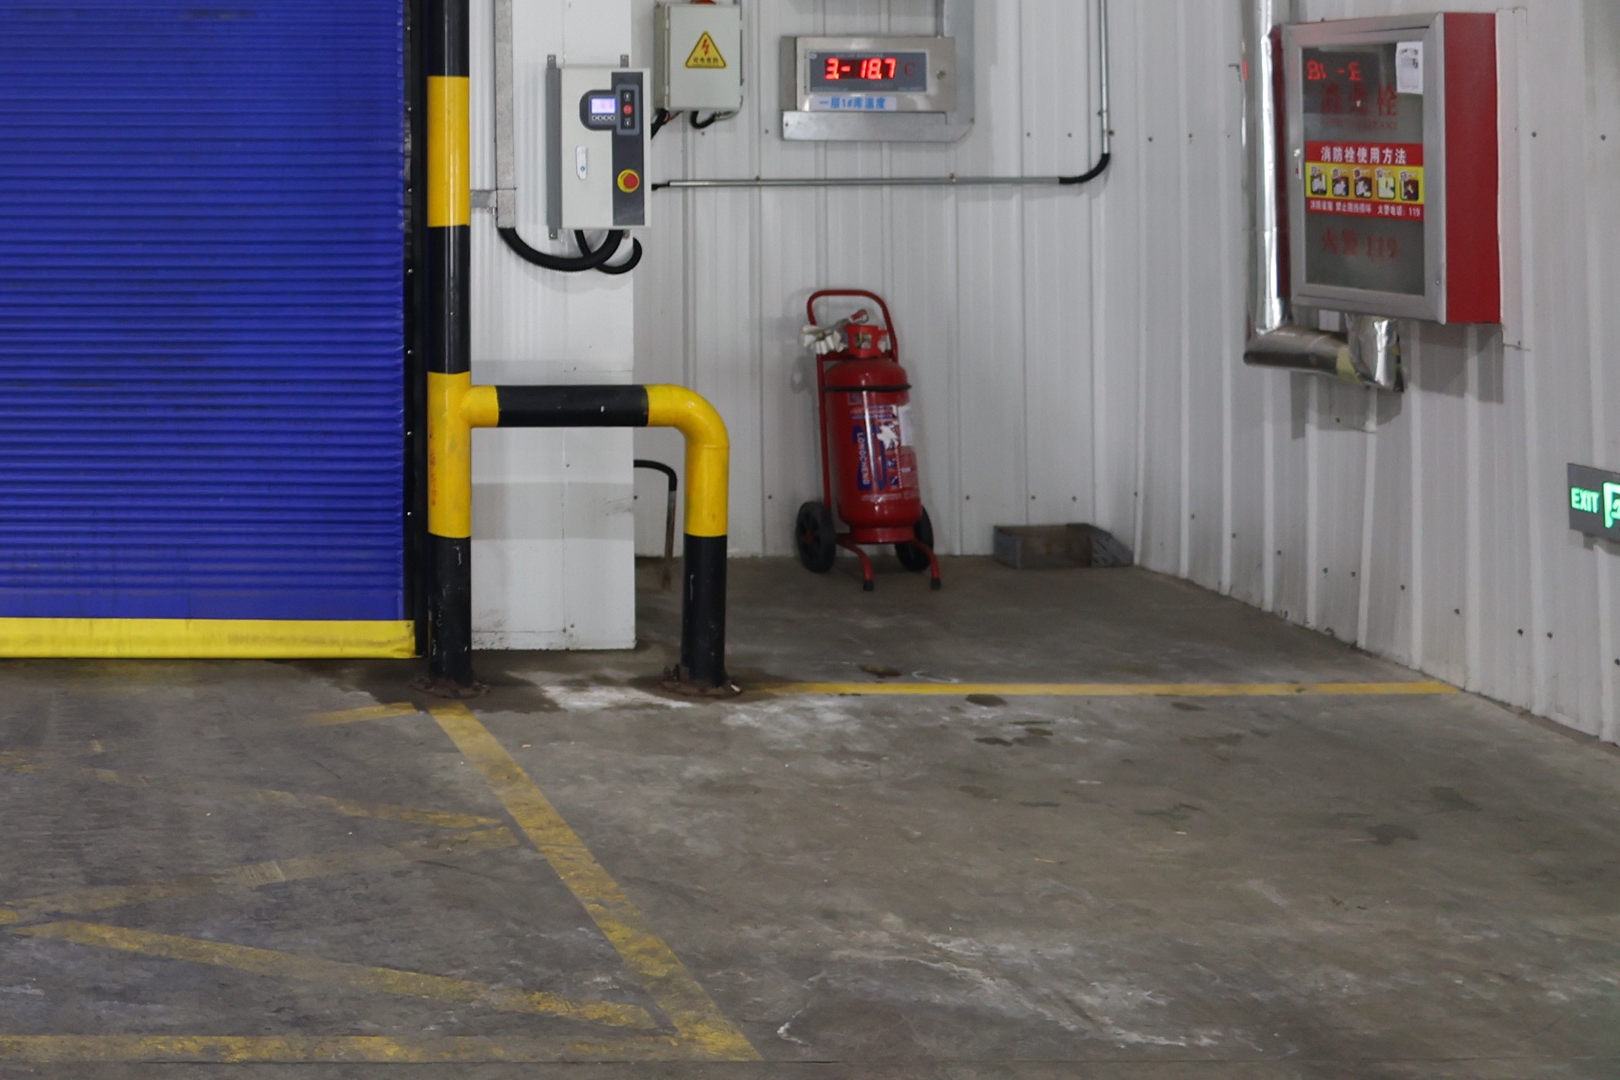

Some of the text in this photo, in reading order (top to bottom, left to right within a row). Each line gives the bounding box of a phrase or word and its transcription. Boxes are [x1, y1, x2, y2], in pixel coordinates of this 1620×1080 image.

[1320, 145, 1408, 165] 消防栓使用方法
[1570, 487, 1600, 514] EXIT
